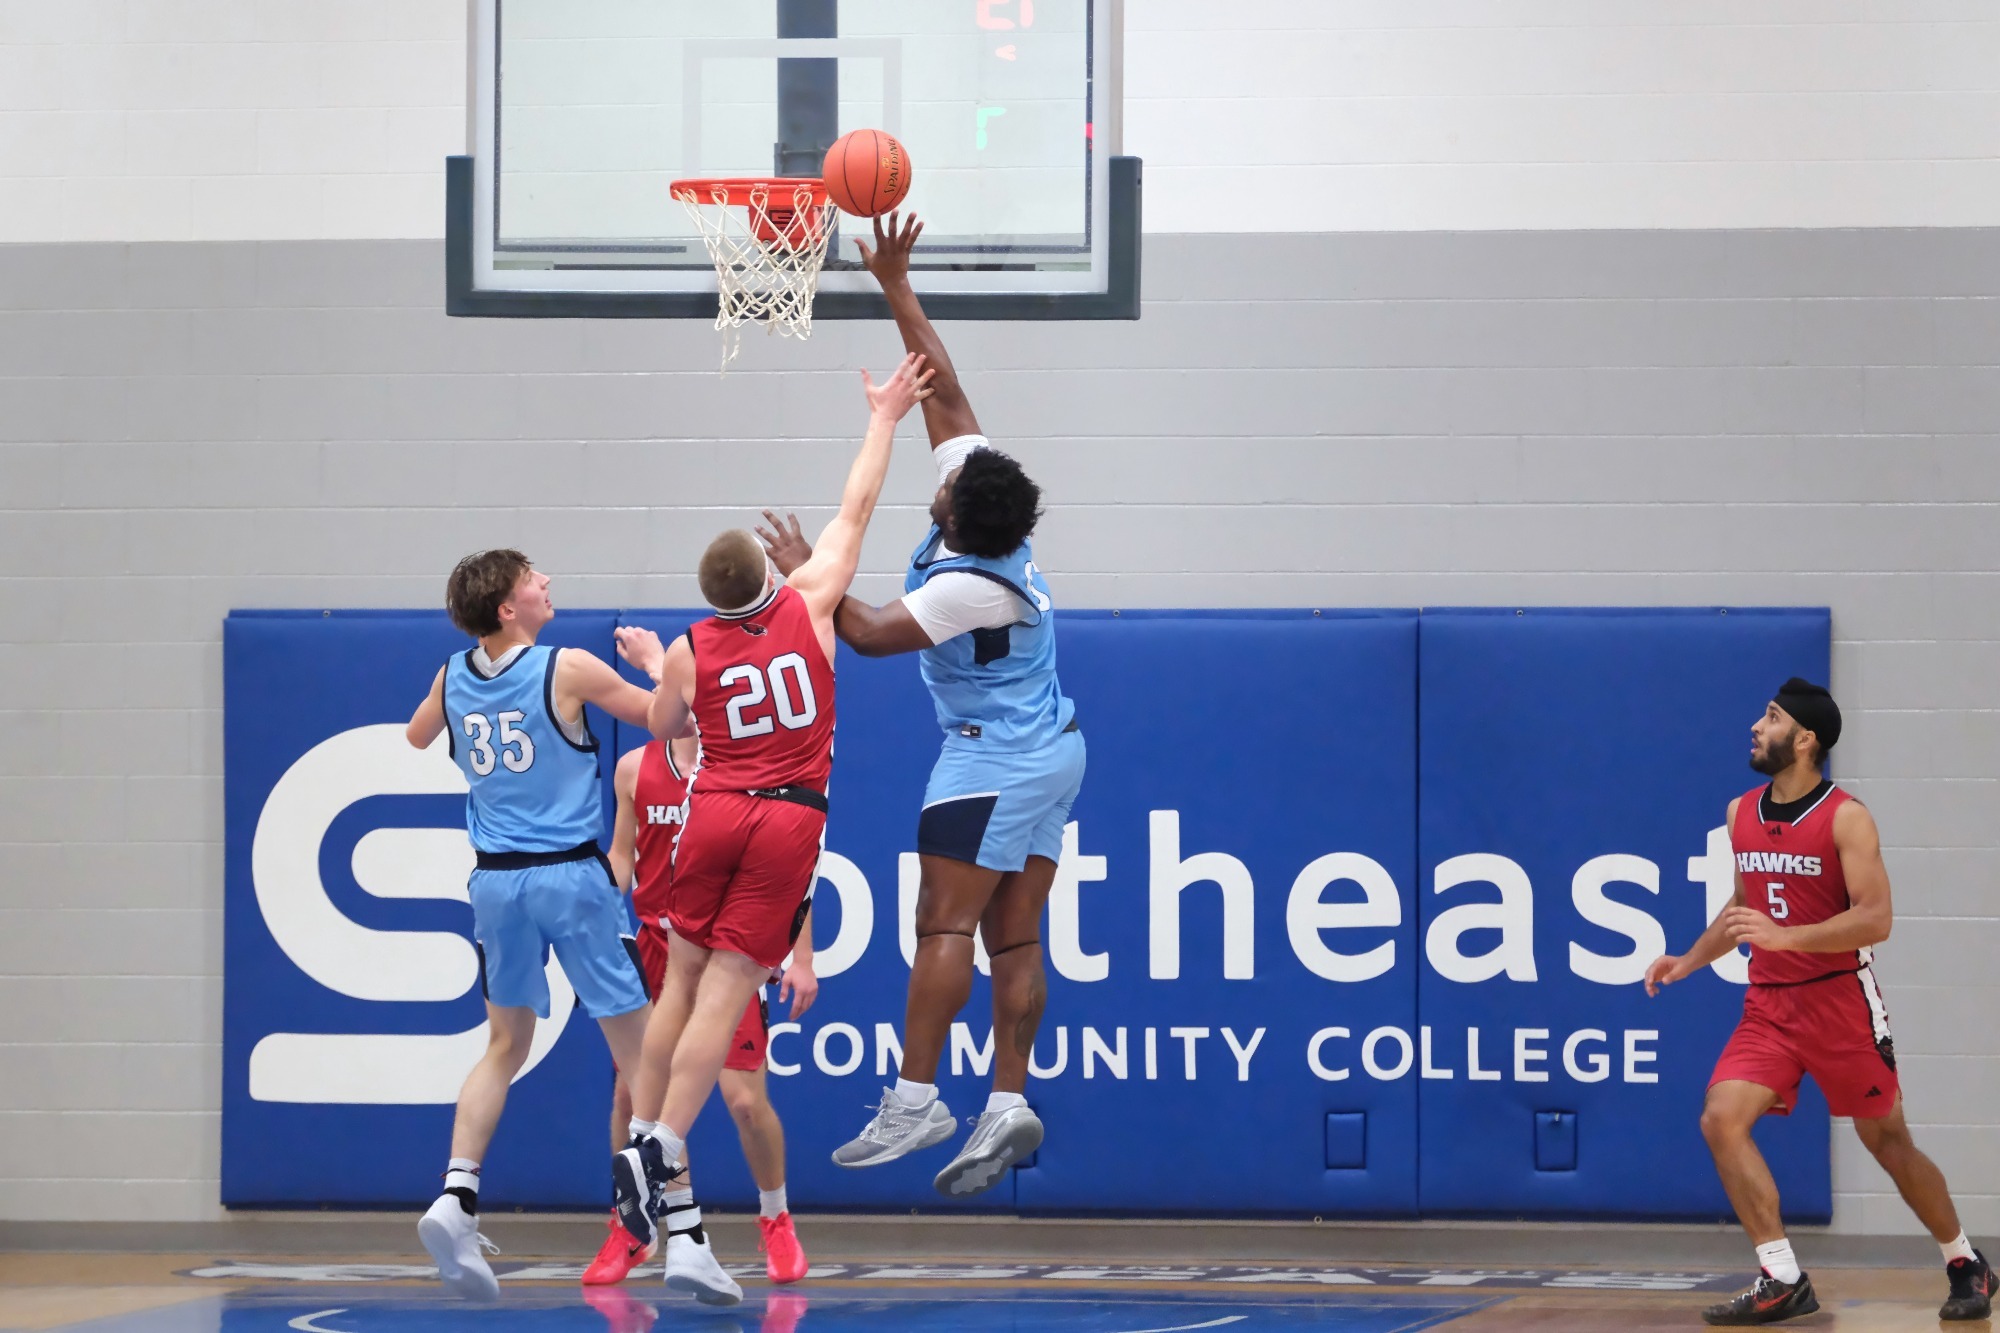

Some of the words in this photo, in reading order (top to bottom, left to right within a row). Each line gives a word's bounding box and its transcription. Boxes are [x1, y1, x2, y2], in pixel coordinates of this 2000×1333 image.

[718, 651, 818, 740] 20
[462, 708, 536, 776] 35
[1736, 851, 1822, 876] HAWKS
[1766, 882, 1789, 919] 5
[1307, 1026, 1659, 1083] COLLEGE
